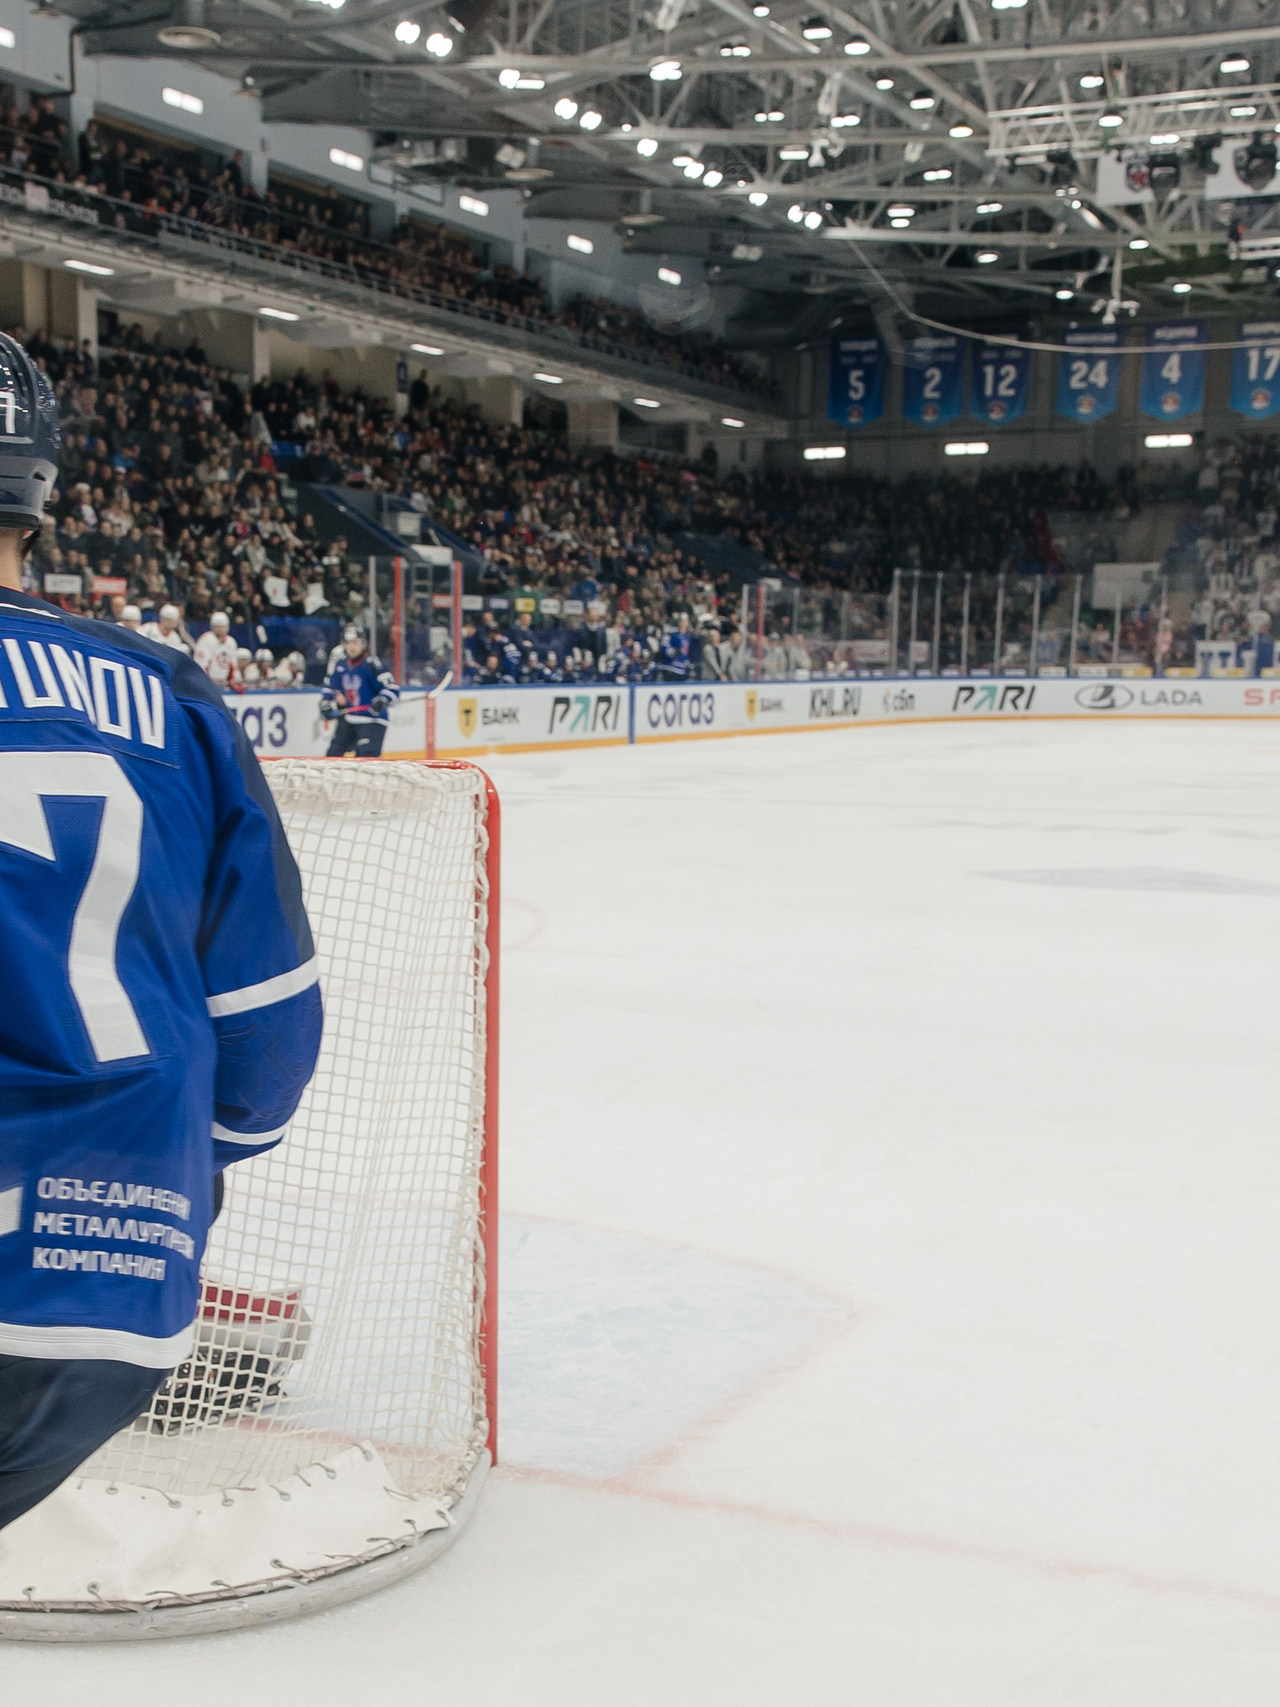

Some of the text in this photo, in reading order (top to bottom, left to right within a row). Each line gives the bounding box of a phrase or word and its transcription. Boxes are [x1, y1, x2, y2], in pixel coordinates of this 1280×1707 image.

[848, 369, 866, 401] 5
[922, 367, 943, 400] 2
[983, 364, 1018, 398] 12
[1069, 359, 1109, 391] 24
[1160, 353, 1182, 386] 4
[1140, 689, 1204, 706] LADA
[482, 706, 521, 726] БАНК
[32, 1246, 167, 1282] КОМПАНИЯ
